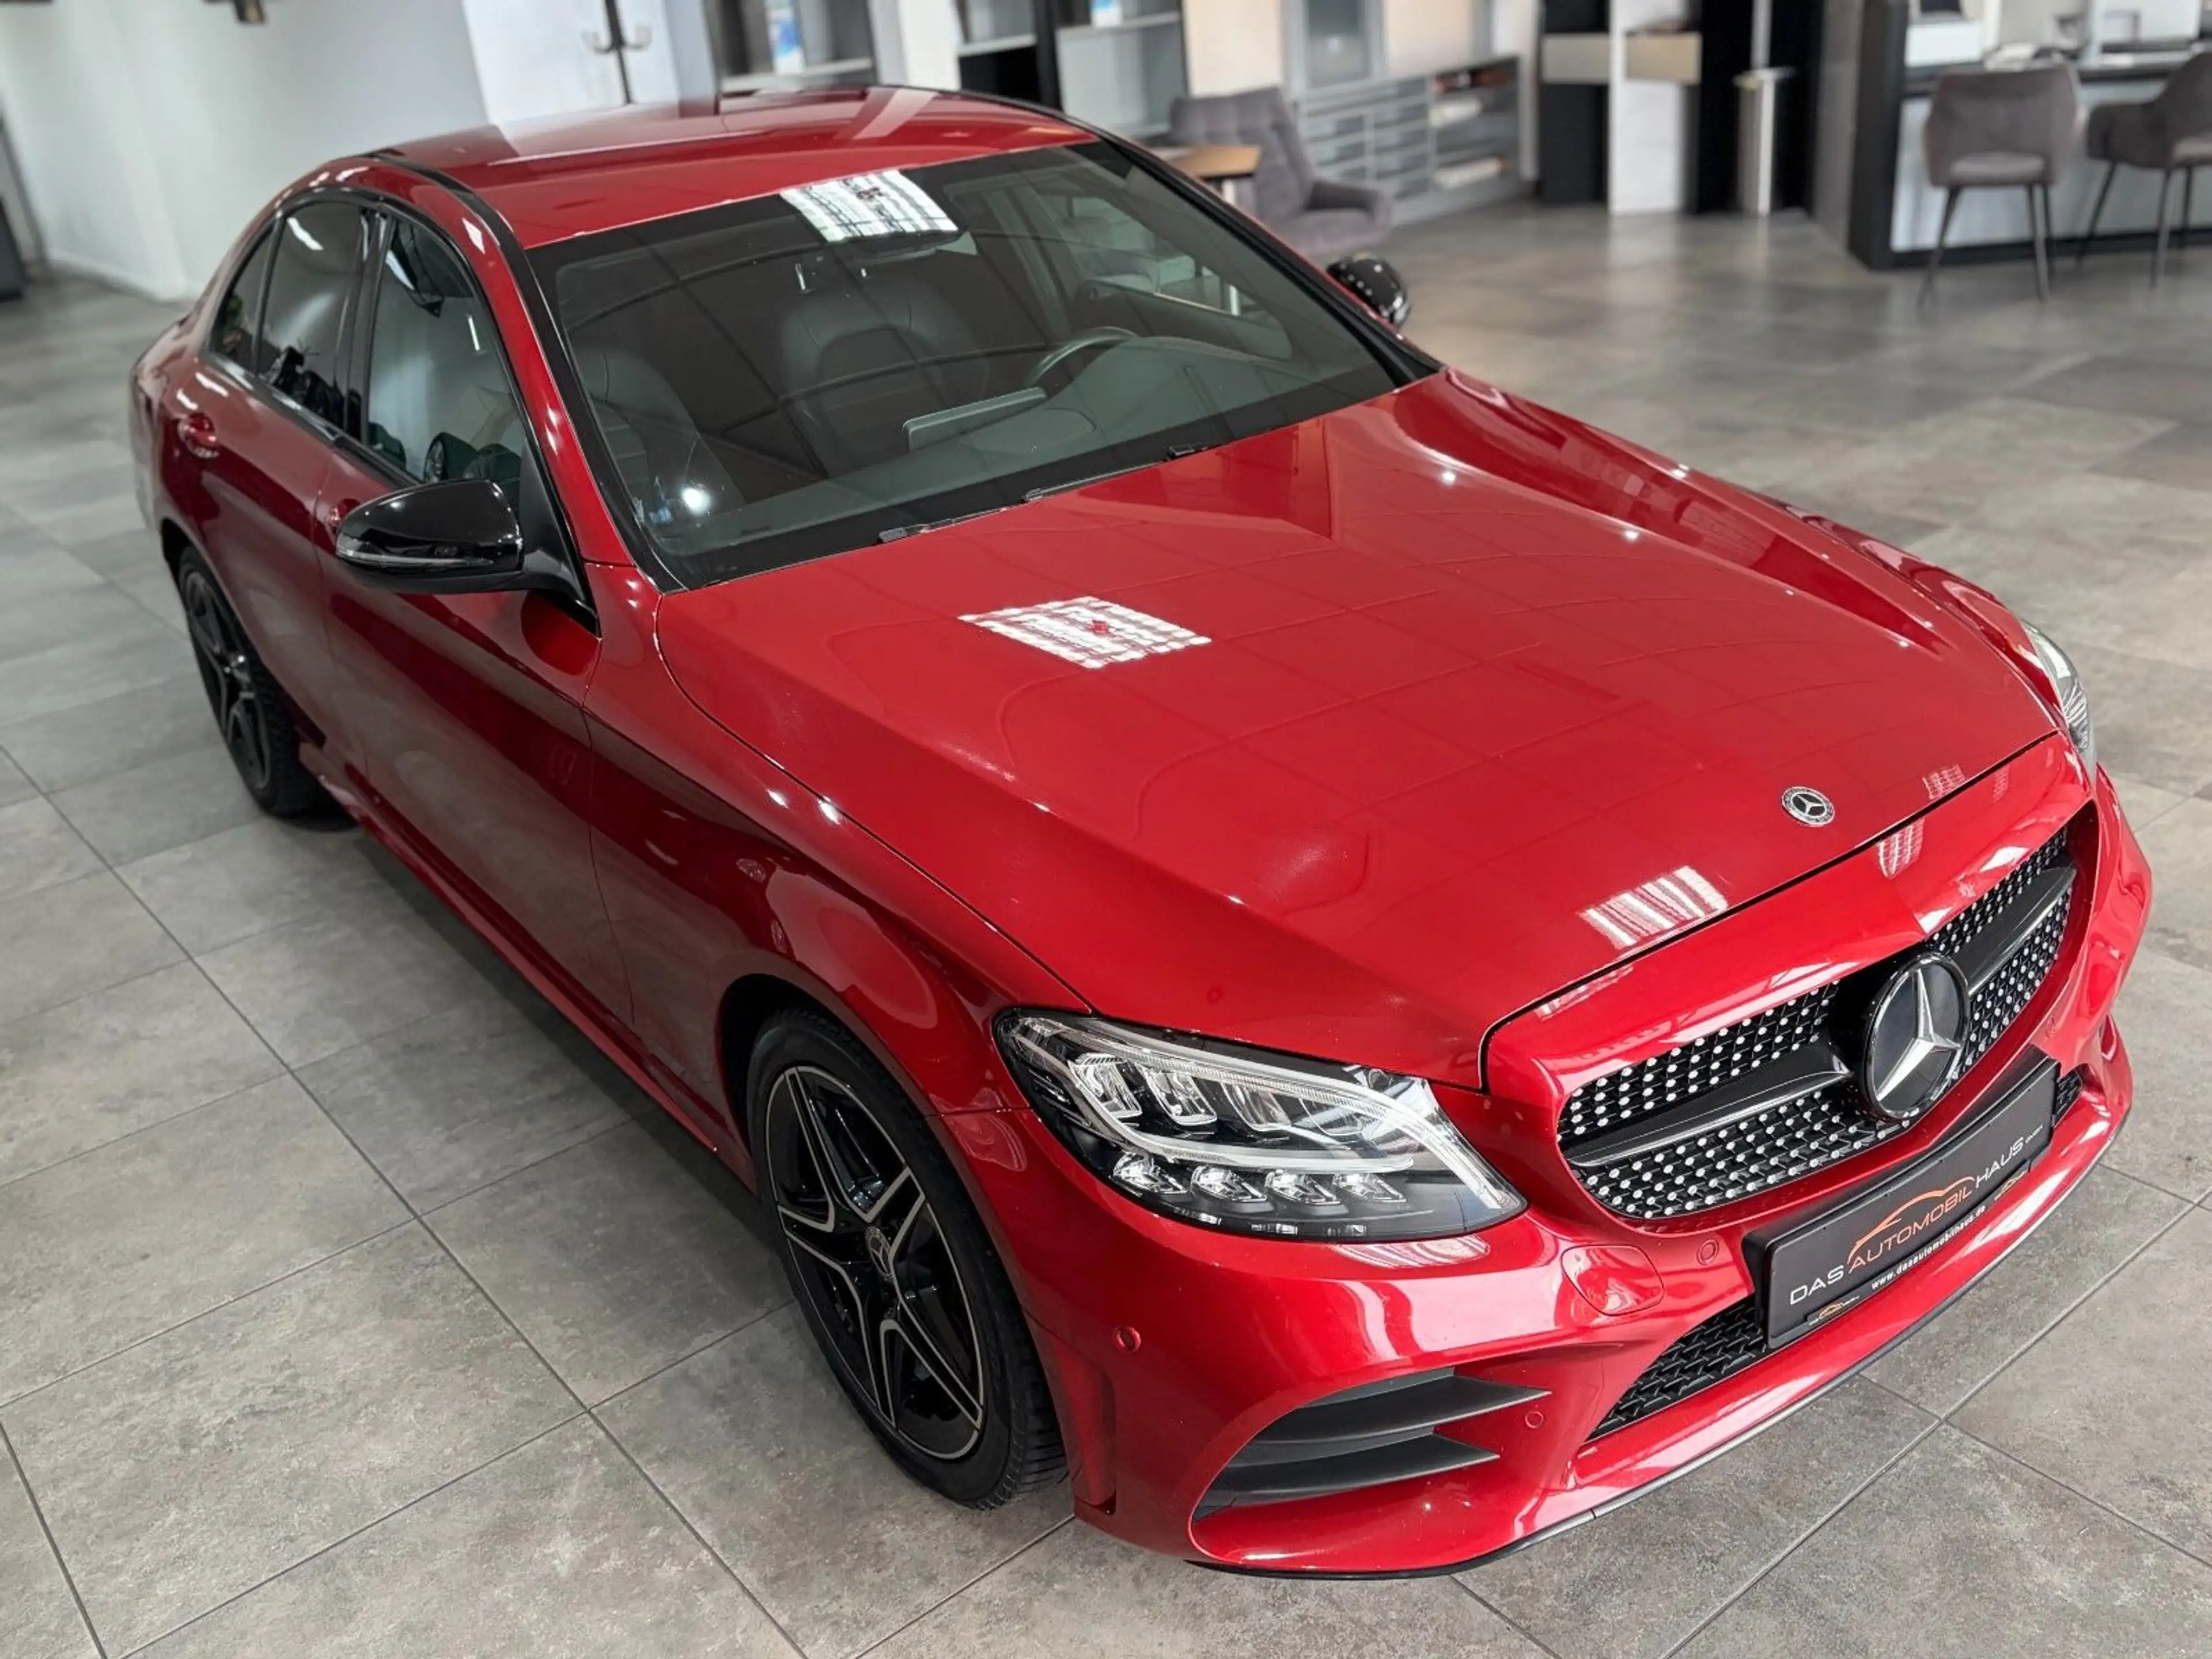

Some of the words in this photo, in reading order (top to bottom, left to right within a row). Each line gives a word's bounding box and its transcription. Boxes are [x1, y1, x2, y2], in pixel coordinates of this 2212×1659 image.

[1790, 1264, 1844, 1305] DAS
[1848, 1186, 1972, 1274] AUTOMOBIL
[1975, 1136, 2024, 1189] HAUS
